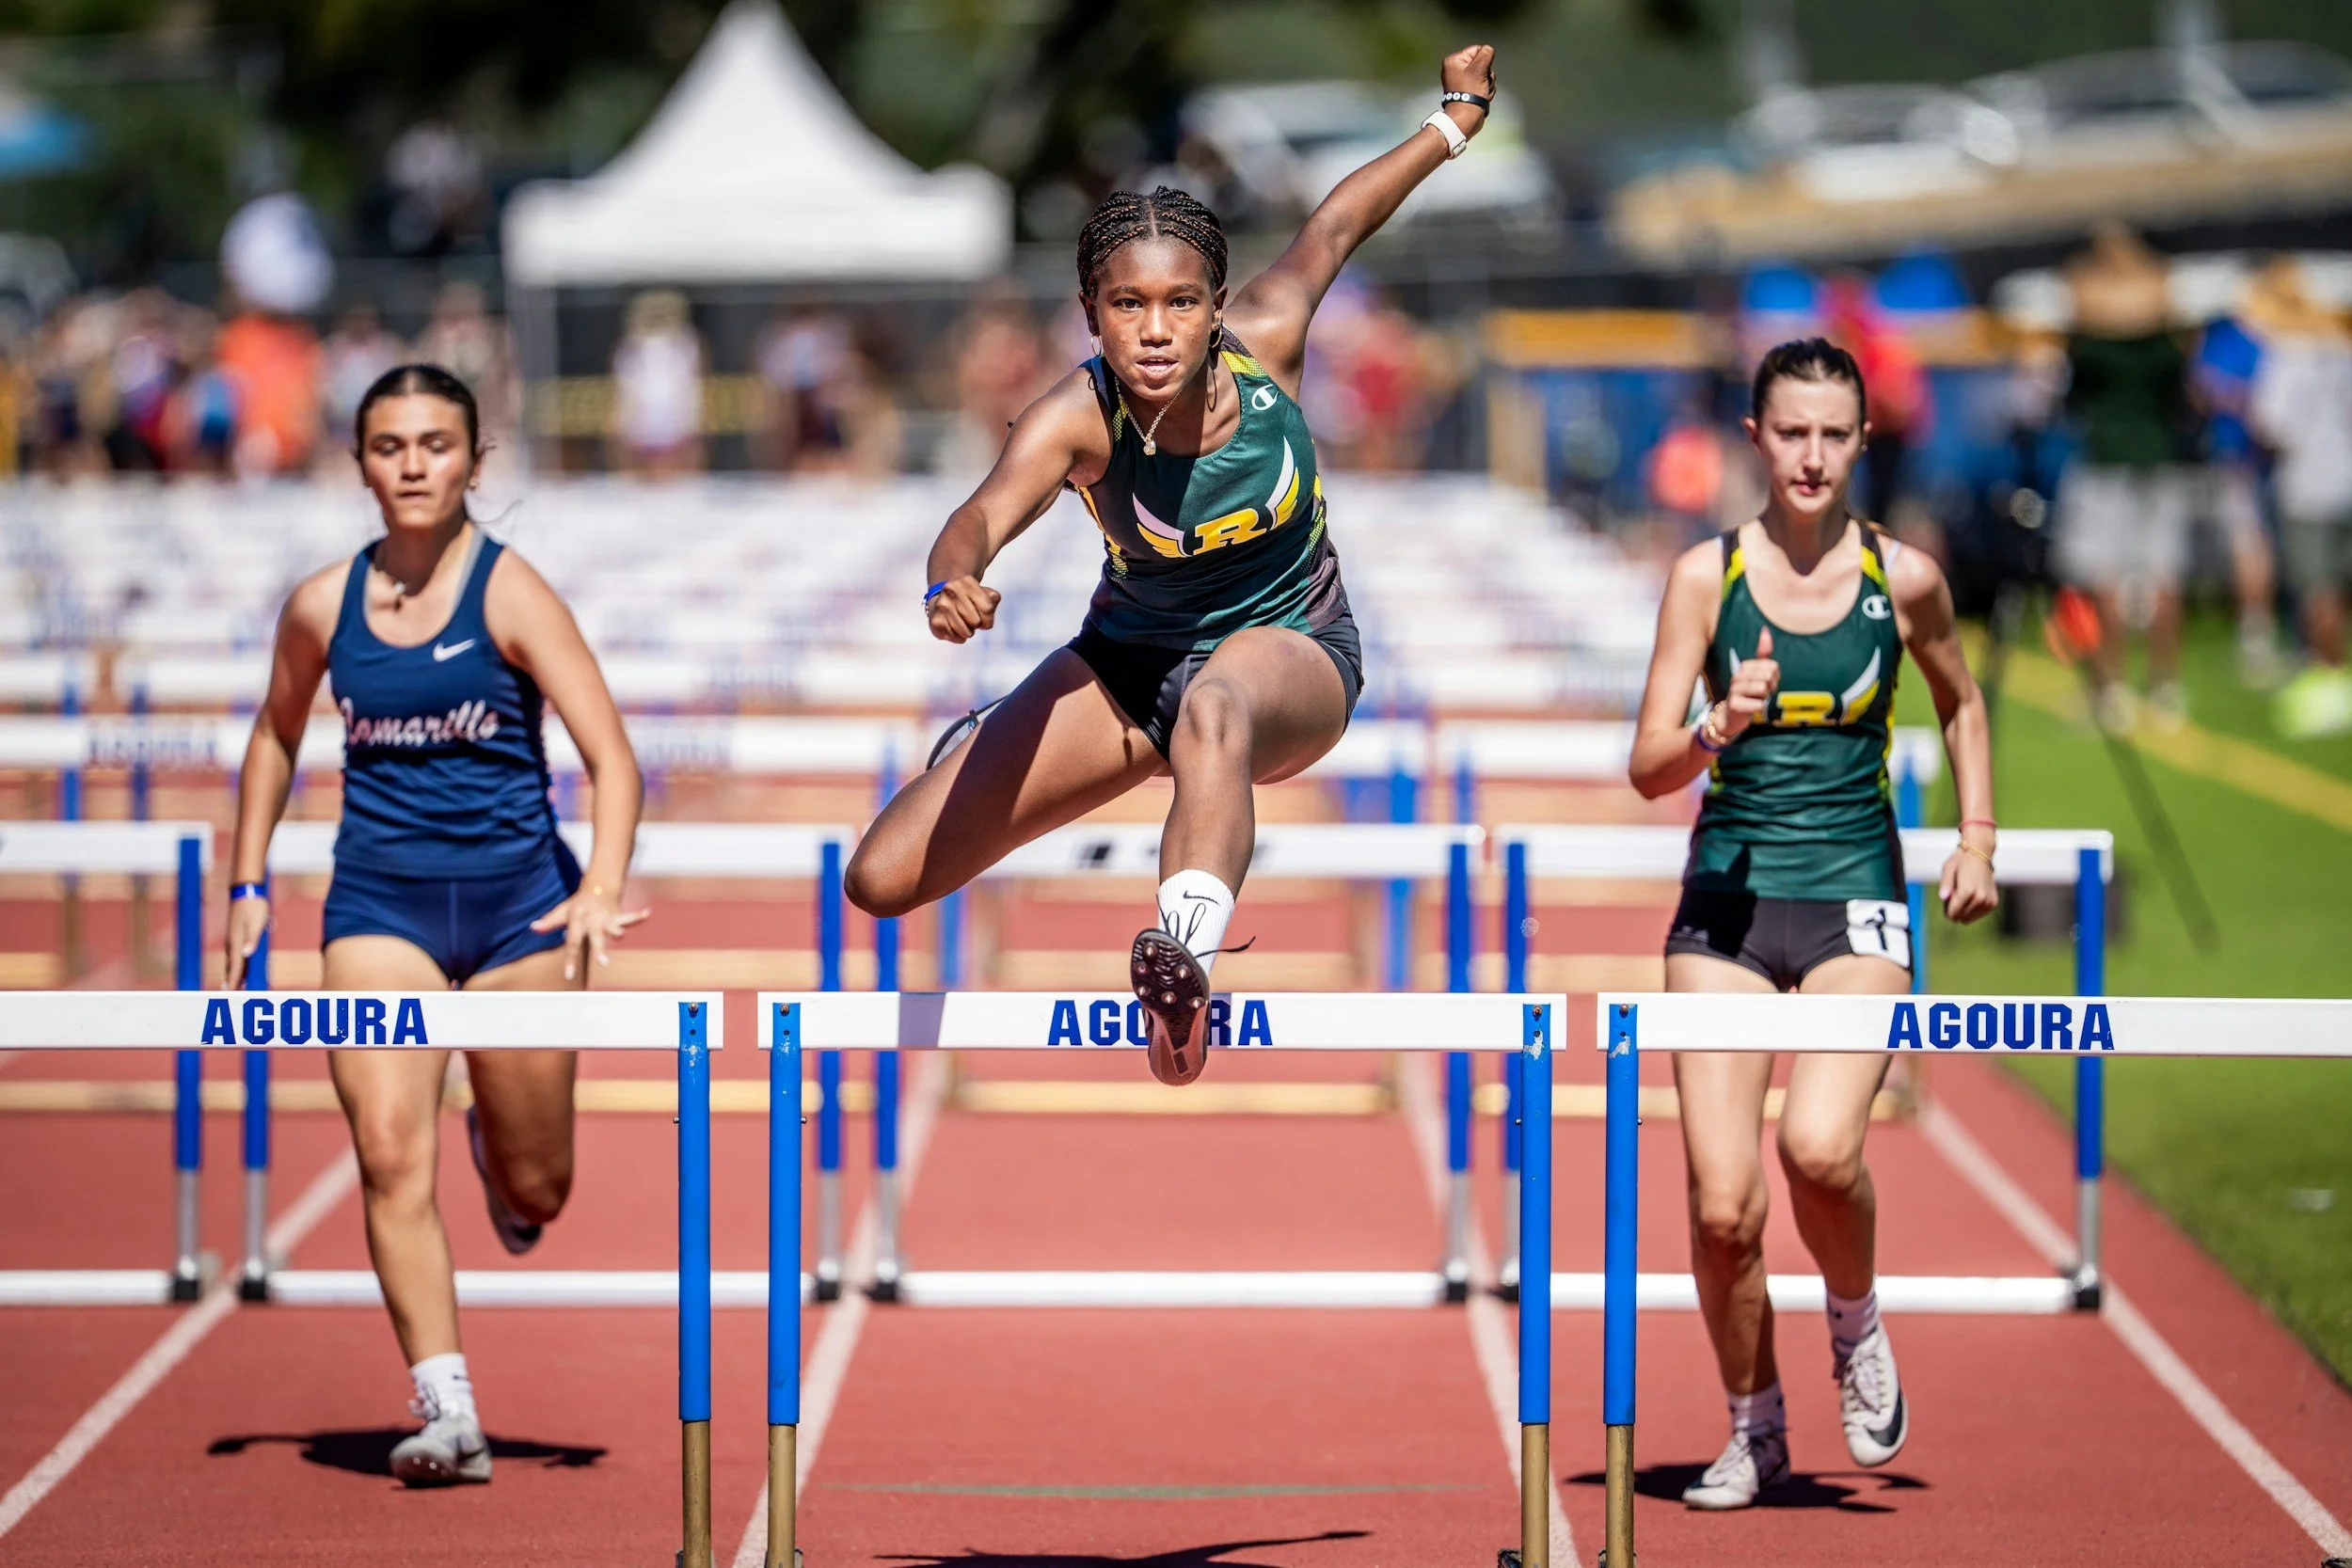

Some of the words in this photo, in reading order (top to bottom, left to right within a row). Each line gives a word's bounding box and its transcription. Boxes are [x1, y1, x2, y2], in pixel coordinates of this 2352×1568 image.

[1192, 508, 1267, 556] R
[1773, 691, 1836, 727] R
[200, 998, 429, 1045] AGOURA
[1047, 1000, 1274, 1046] AGORA
[1886, 1002, 2115, 1051] AGOURA
